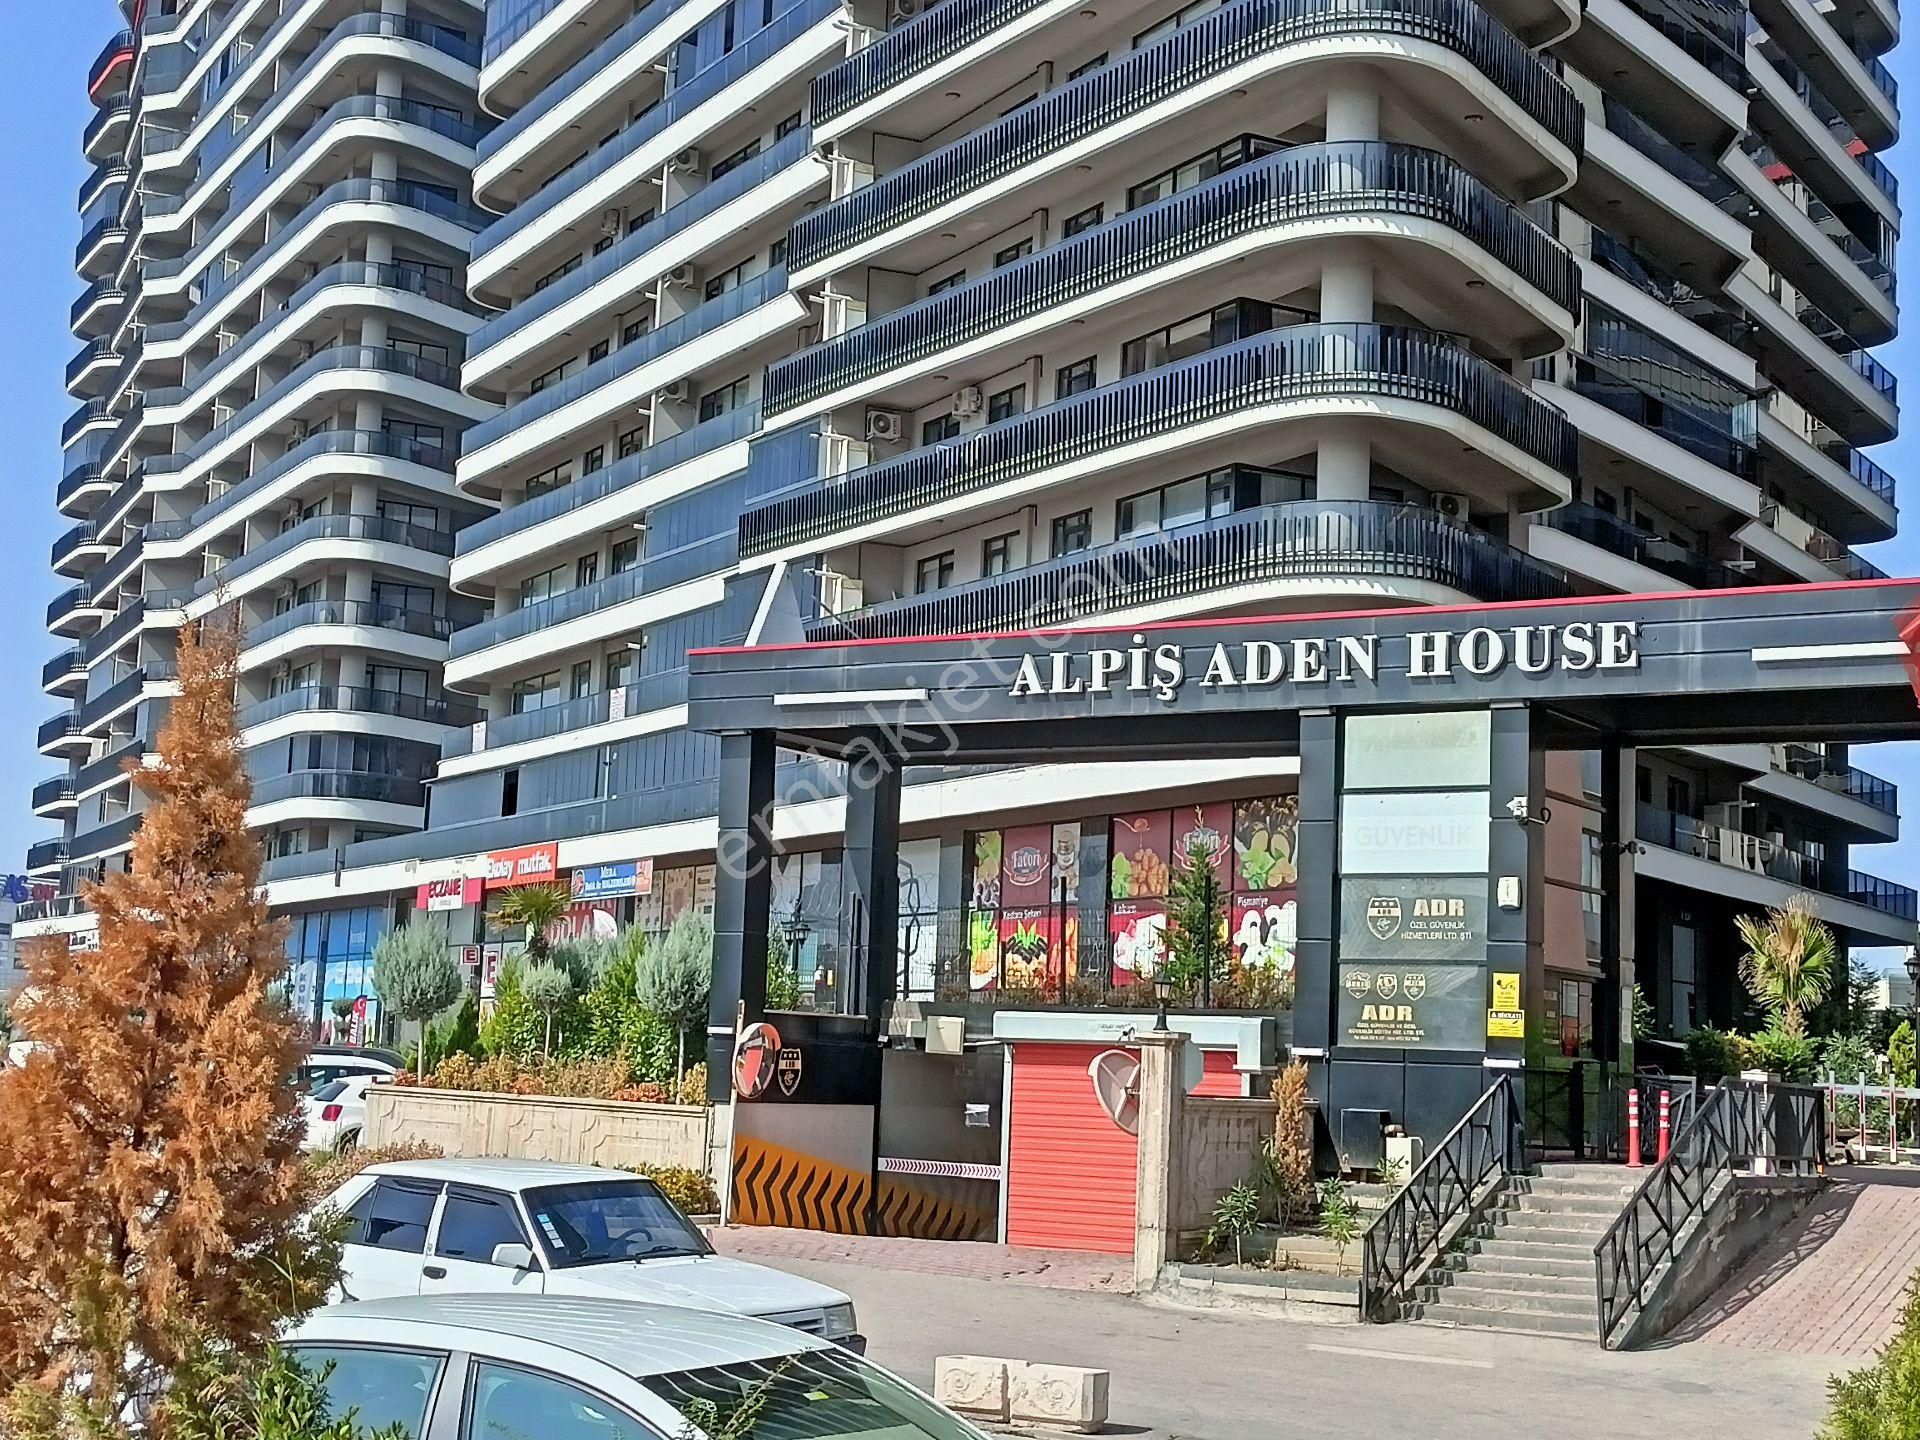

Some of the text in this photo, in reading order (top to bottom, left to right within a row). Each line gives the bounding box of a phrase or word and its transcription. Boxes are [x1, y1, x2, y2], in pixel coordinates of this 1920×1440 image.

[1008, 620, 1641, 702] ALPİŞ ADEN HOUSE
[1356, 819, 1473, 847] GÜVENLİK
[517, 850, 553, 876] mutfak
[428, 878, 462, 899] ECZANE
[1413, 898, 1465, 917] ADR
[1409, 920, 1466, 929] ÖZEL GÜVENLİK
[1400, 930, 1443, 940] HİZMETLERİ
[466, 949, 476, 961] E
[487, 955, 497, 985] E
[1362, 1005, 1413, 1021] ADR
